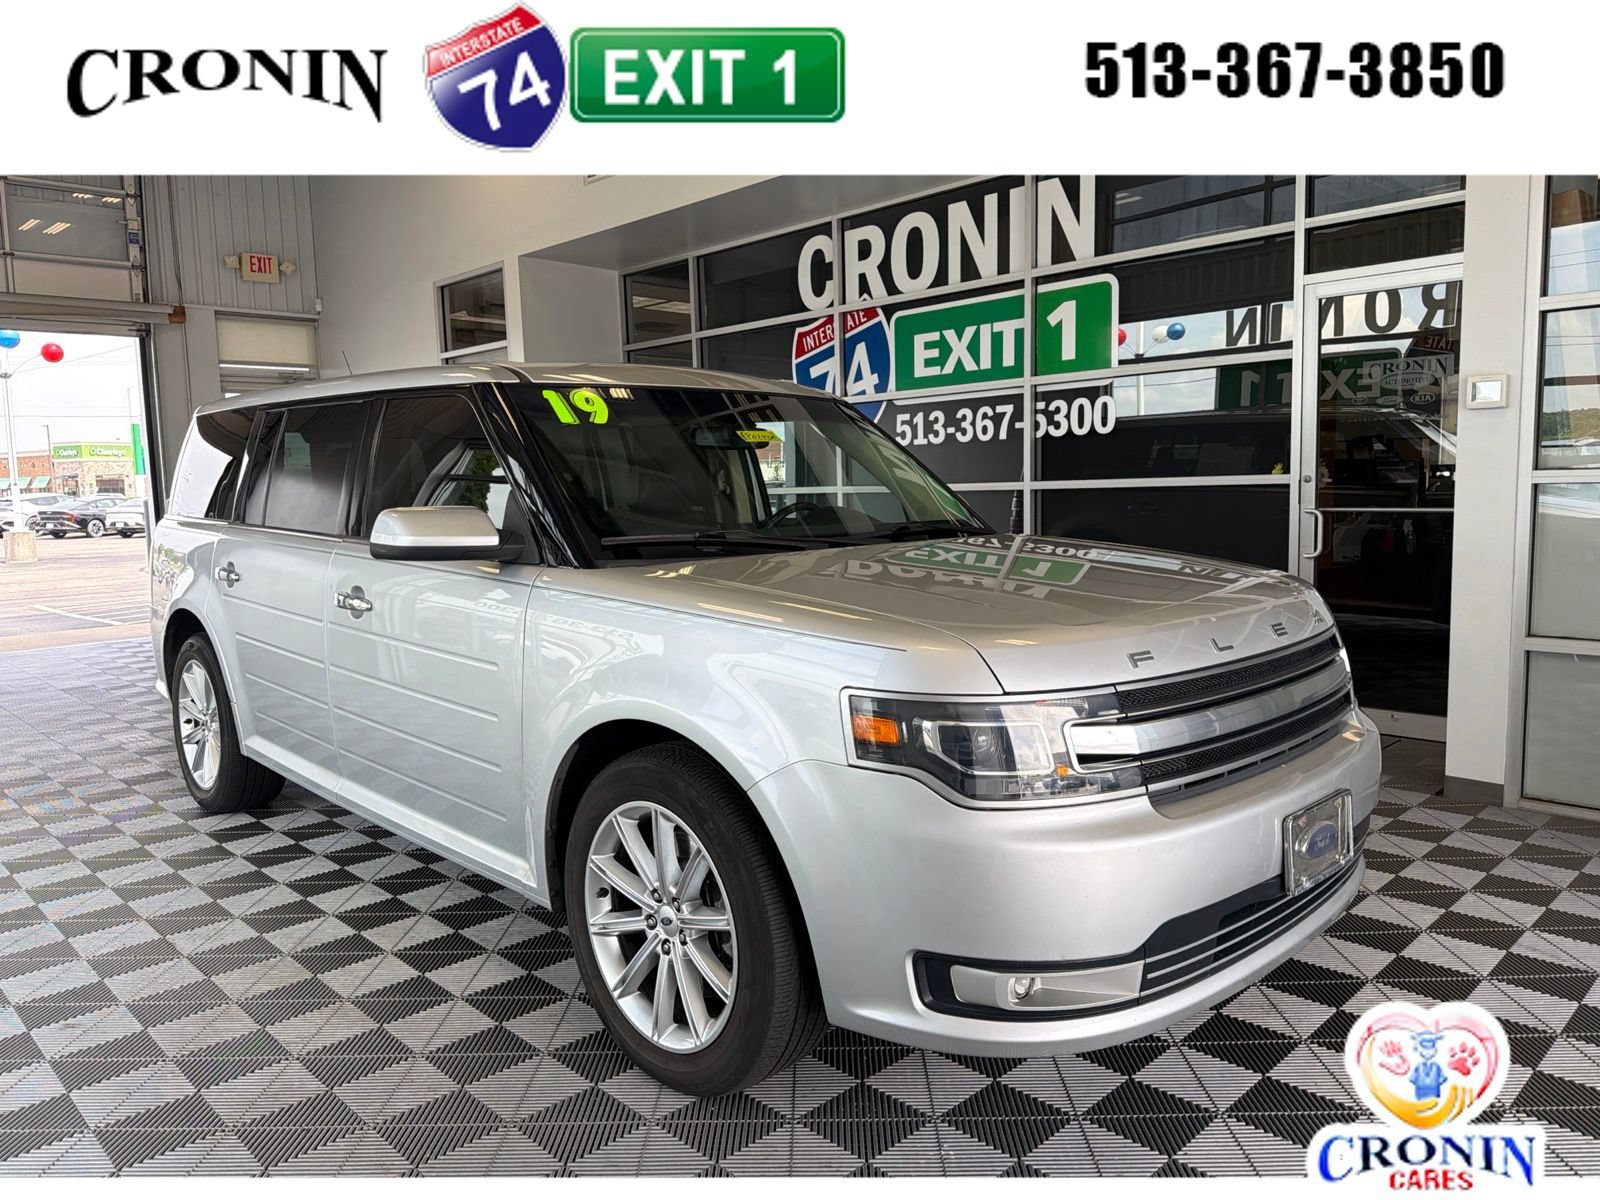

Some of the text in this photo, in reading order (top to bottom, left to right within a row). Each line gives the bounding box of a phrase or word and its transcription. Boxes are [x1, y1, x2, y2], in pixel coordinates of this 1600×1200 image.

[249, 255, 272, 274] EXIT
[798, 174, 1095, 312] CRONIN
[913, 300, 1077, 378] EXIT 1
[809, 341, 880, 396] 74
[1368, 357, 1448, 380] CRONIN
[542, 389, 609, 424] 19
[896, 395, 1116, 447] 513-367-5300
[1127, 609, 1324, 669] FLEX
